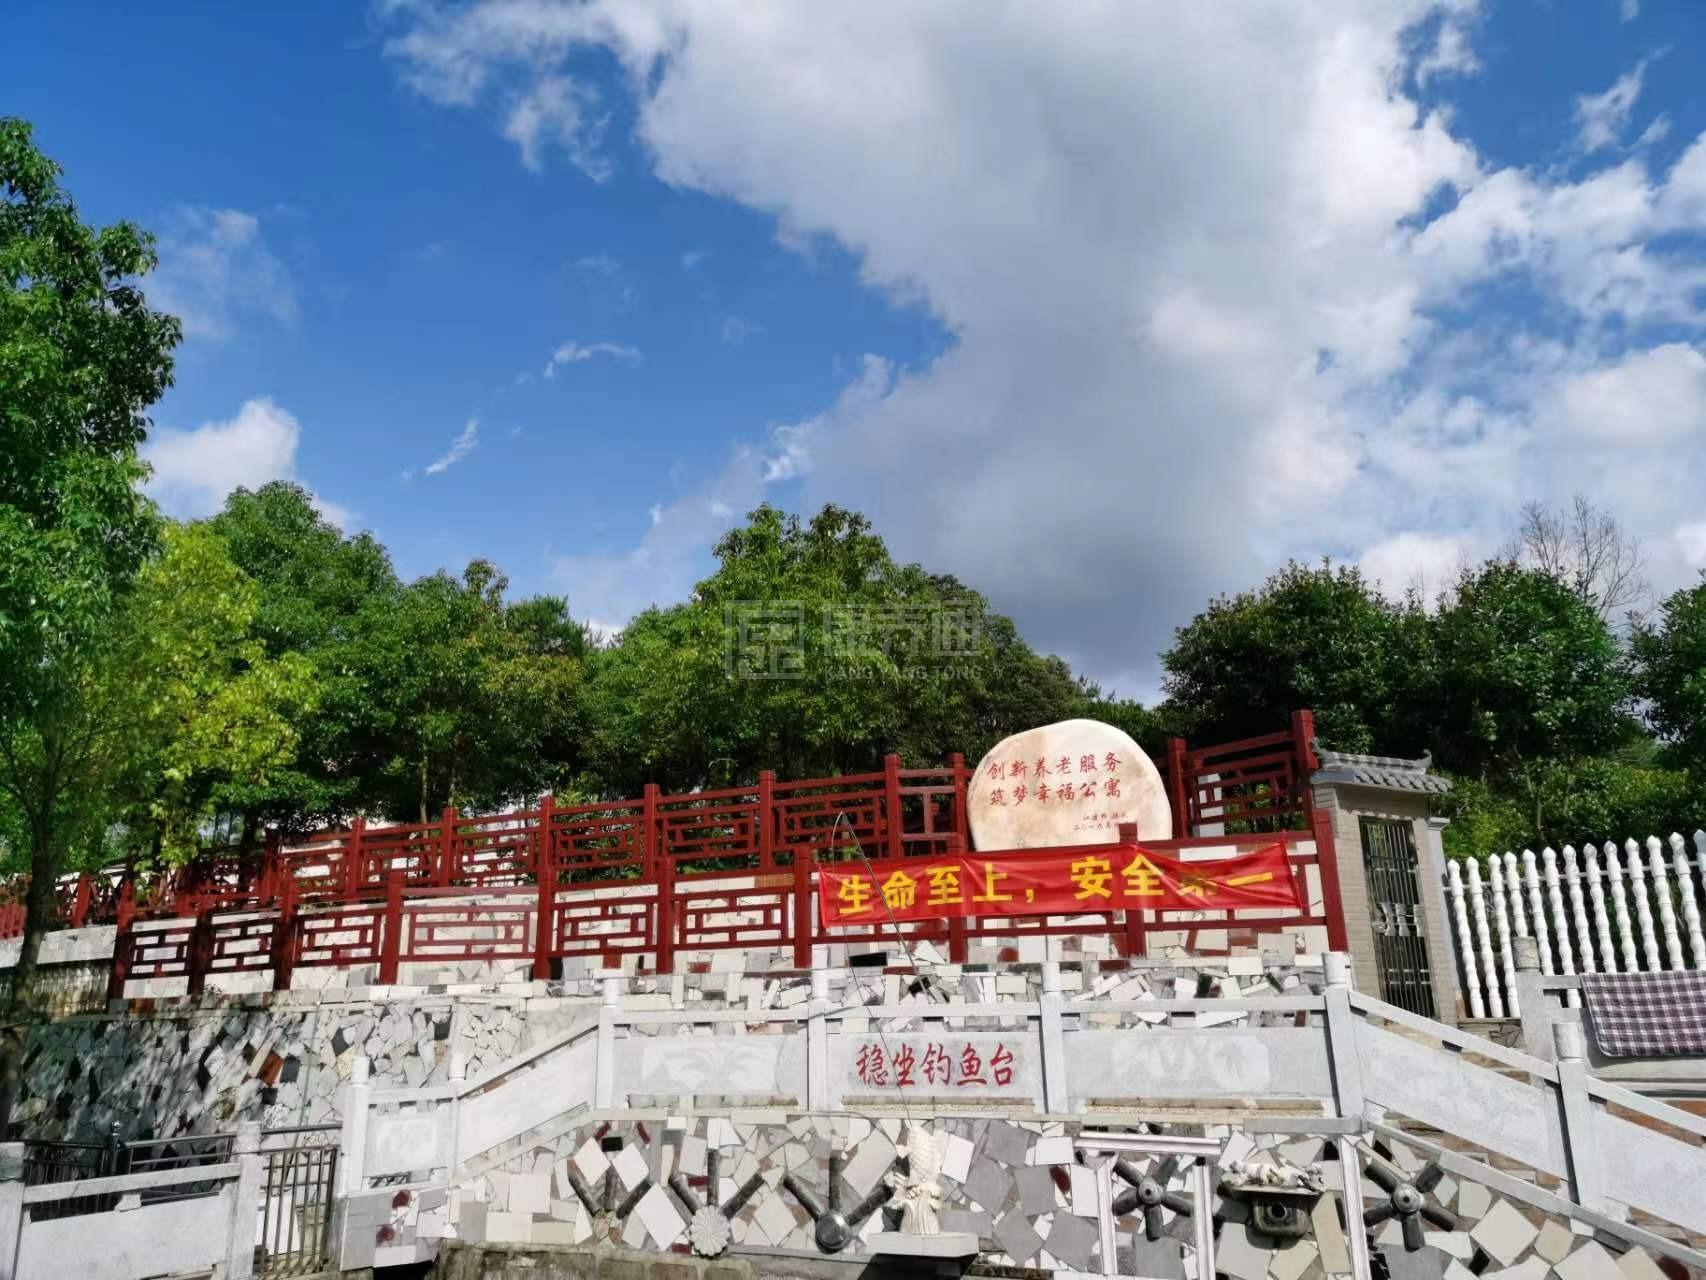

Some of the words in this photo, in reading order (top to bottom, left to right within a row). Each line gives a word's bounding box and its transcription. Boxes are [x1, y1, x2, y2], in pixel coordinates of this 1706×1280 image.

[986, 751, 1122, 781] 创新养老服务
[989, 777, 1121, 807] 筑梦幸福公寓
[856, 1042, 1013, 1087] 稳坐钓鱼台
